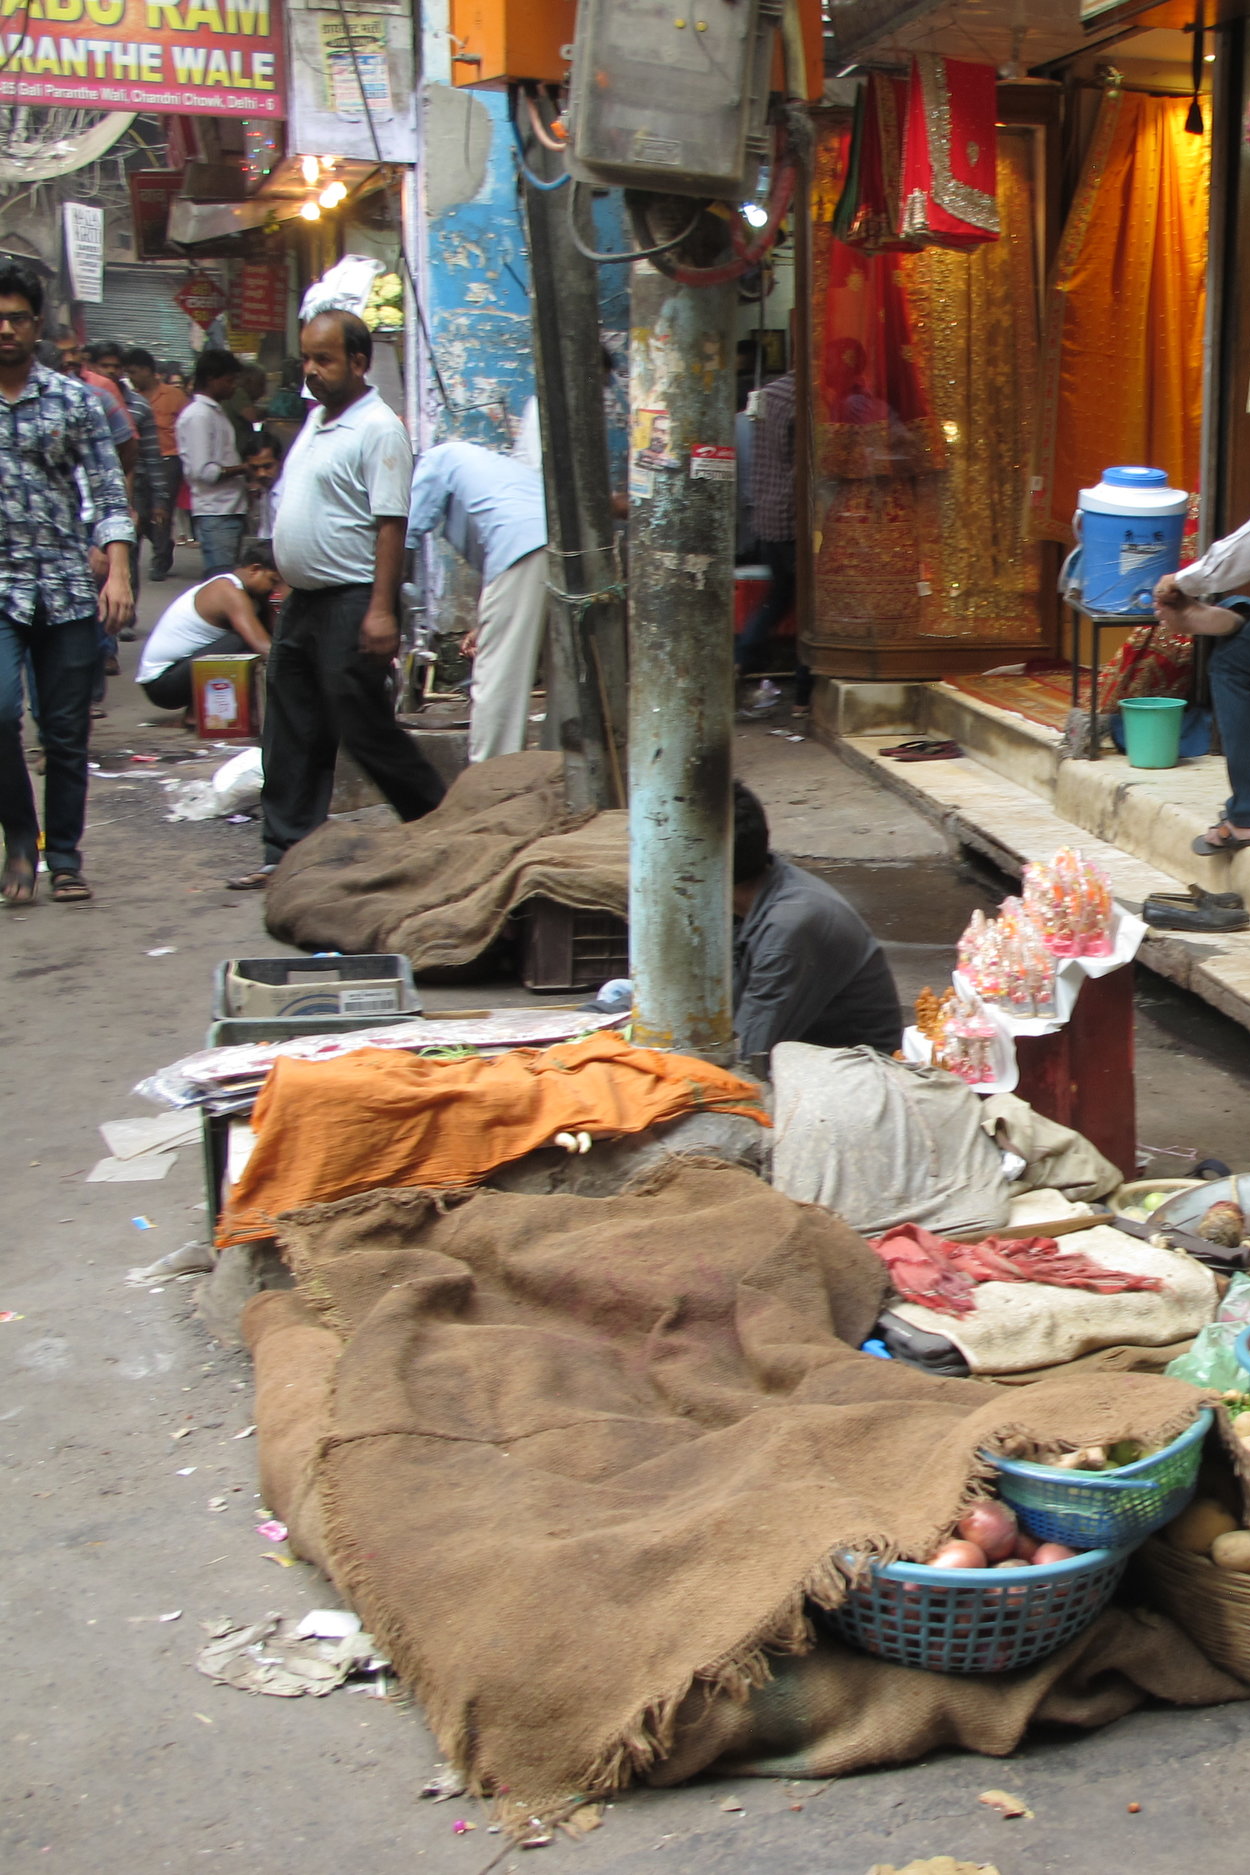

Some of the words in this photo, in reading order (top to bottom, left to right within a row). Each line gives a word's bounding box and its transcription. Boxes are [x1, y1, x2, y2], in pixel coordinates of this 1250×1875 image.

[146, 0, 271, 37] RAM
[171, 46, 276, 91] WALE
[18, 82, 43, 97] Gali
[45, 84, 99, 100] Paranthe
[131, 89, 182, 105] Chandni
[227, 95, 258, 109] Delhi
[265, 98, 276, 111] 6
